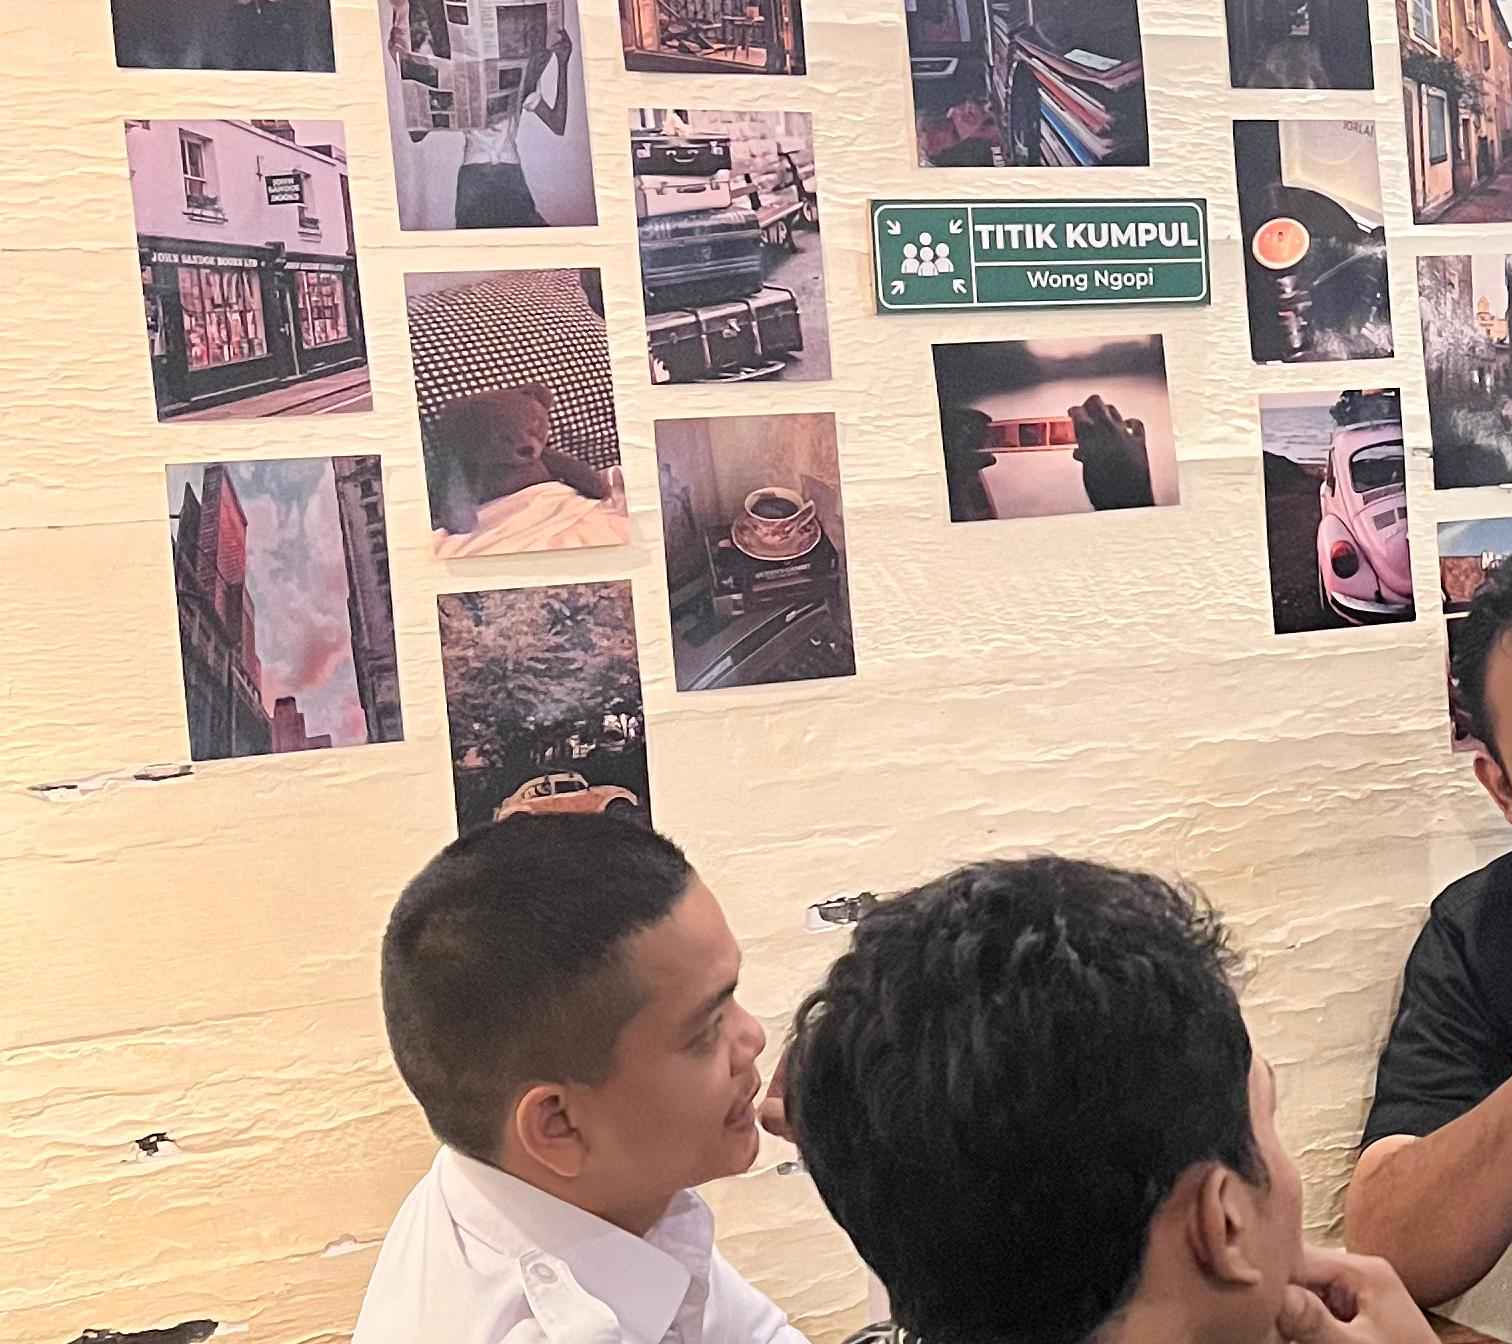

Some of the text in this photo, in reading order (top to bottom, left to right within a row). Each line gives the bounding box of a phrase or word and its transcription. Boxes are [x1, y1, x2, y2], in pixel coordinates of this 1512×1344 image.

[974, 222, 1199, 250] TITIK KUMPUL
[1026, 267, 1155, 291] Wong Ngopi
